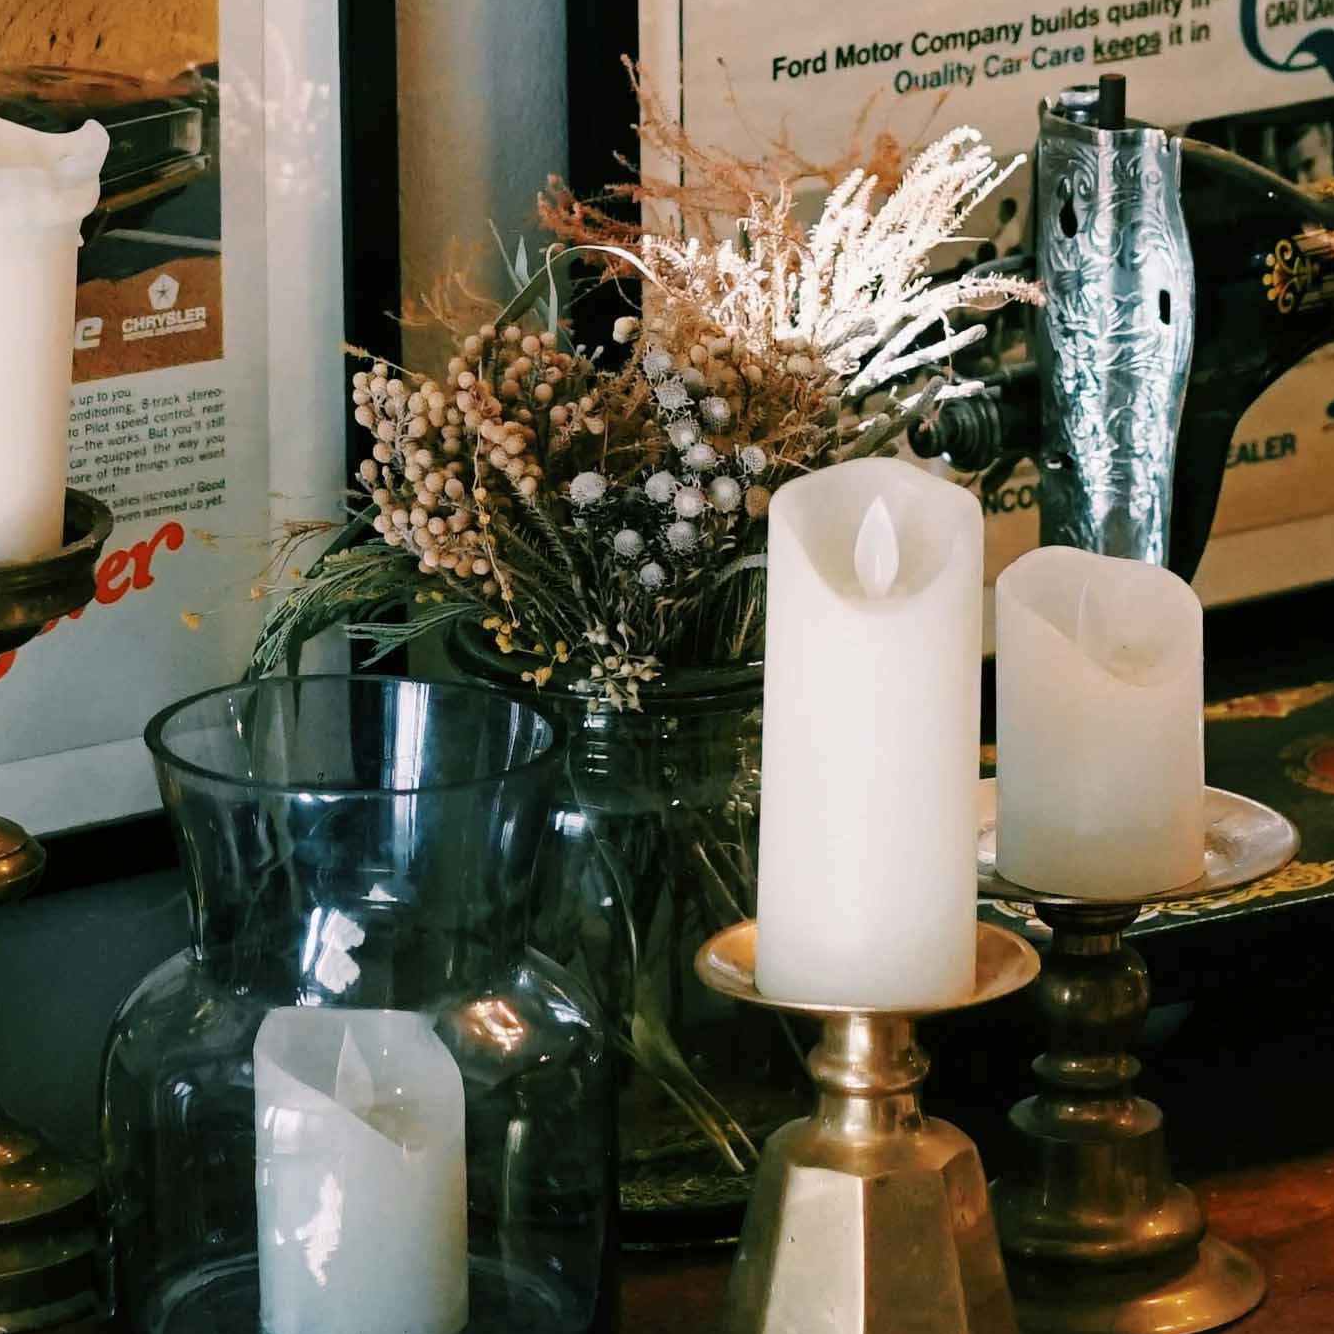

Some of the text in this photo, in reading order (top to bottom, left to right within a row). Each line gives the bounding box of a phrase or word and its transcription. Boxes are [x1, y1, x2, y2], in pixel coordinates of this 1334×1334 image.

[1265, 0, 1298, 29] CAR
[772, 49, 827, 81] Ford
[835, 41, 904, 70] Motor
[910, 22, 1023, 57] Company
[1030, 7, 1100, 37] builds
[893, 20, 1210, 95] Quality Car Care keeps it in
[122, 307, 206, 334] CHRYSLER
